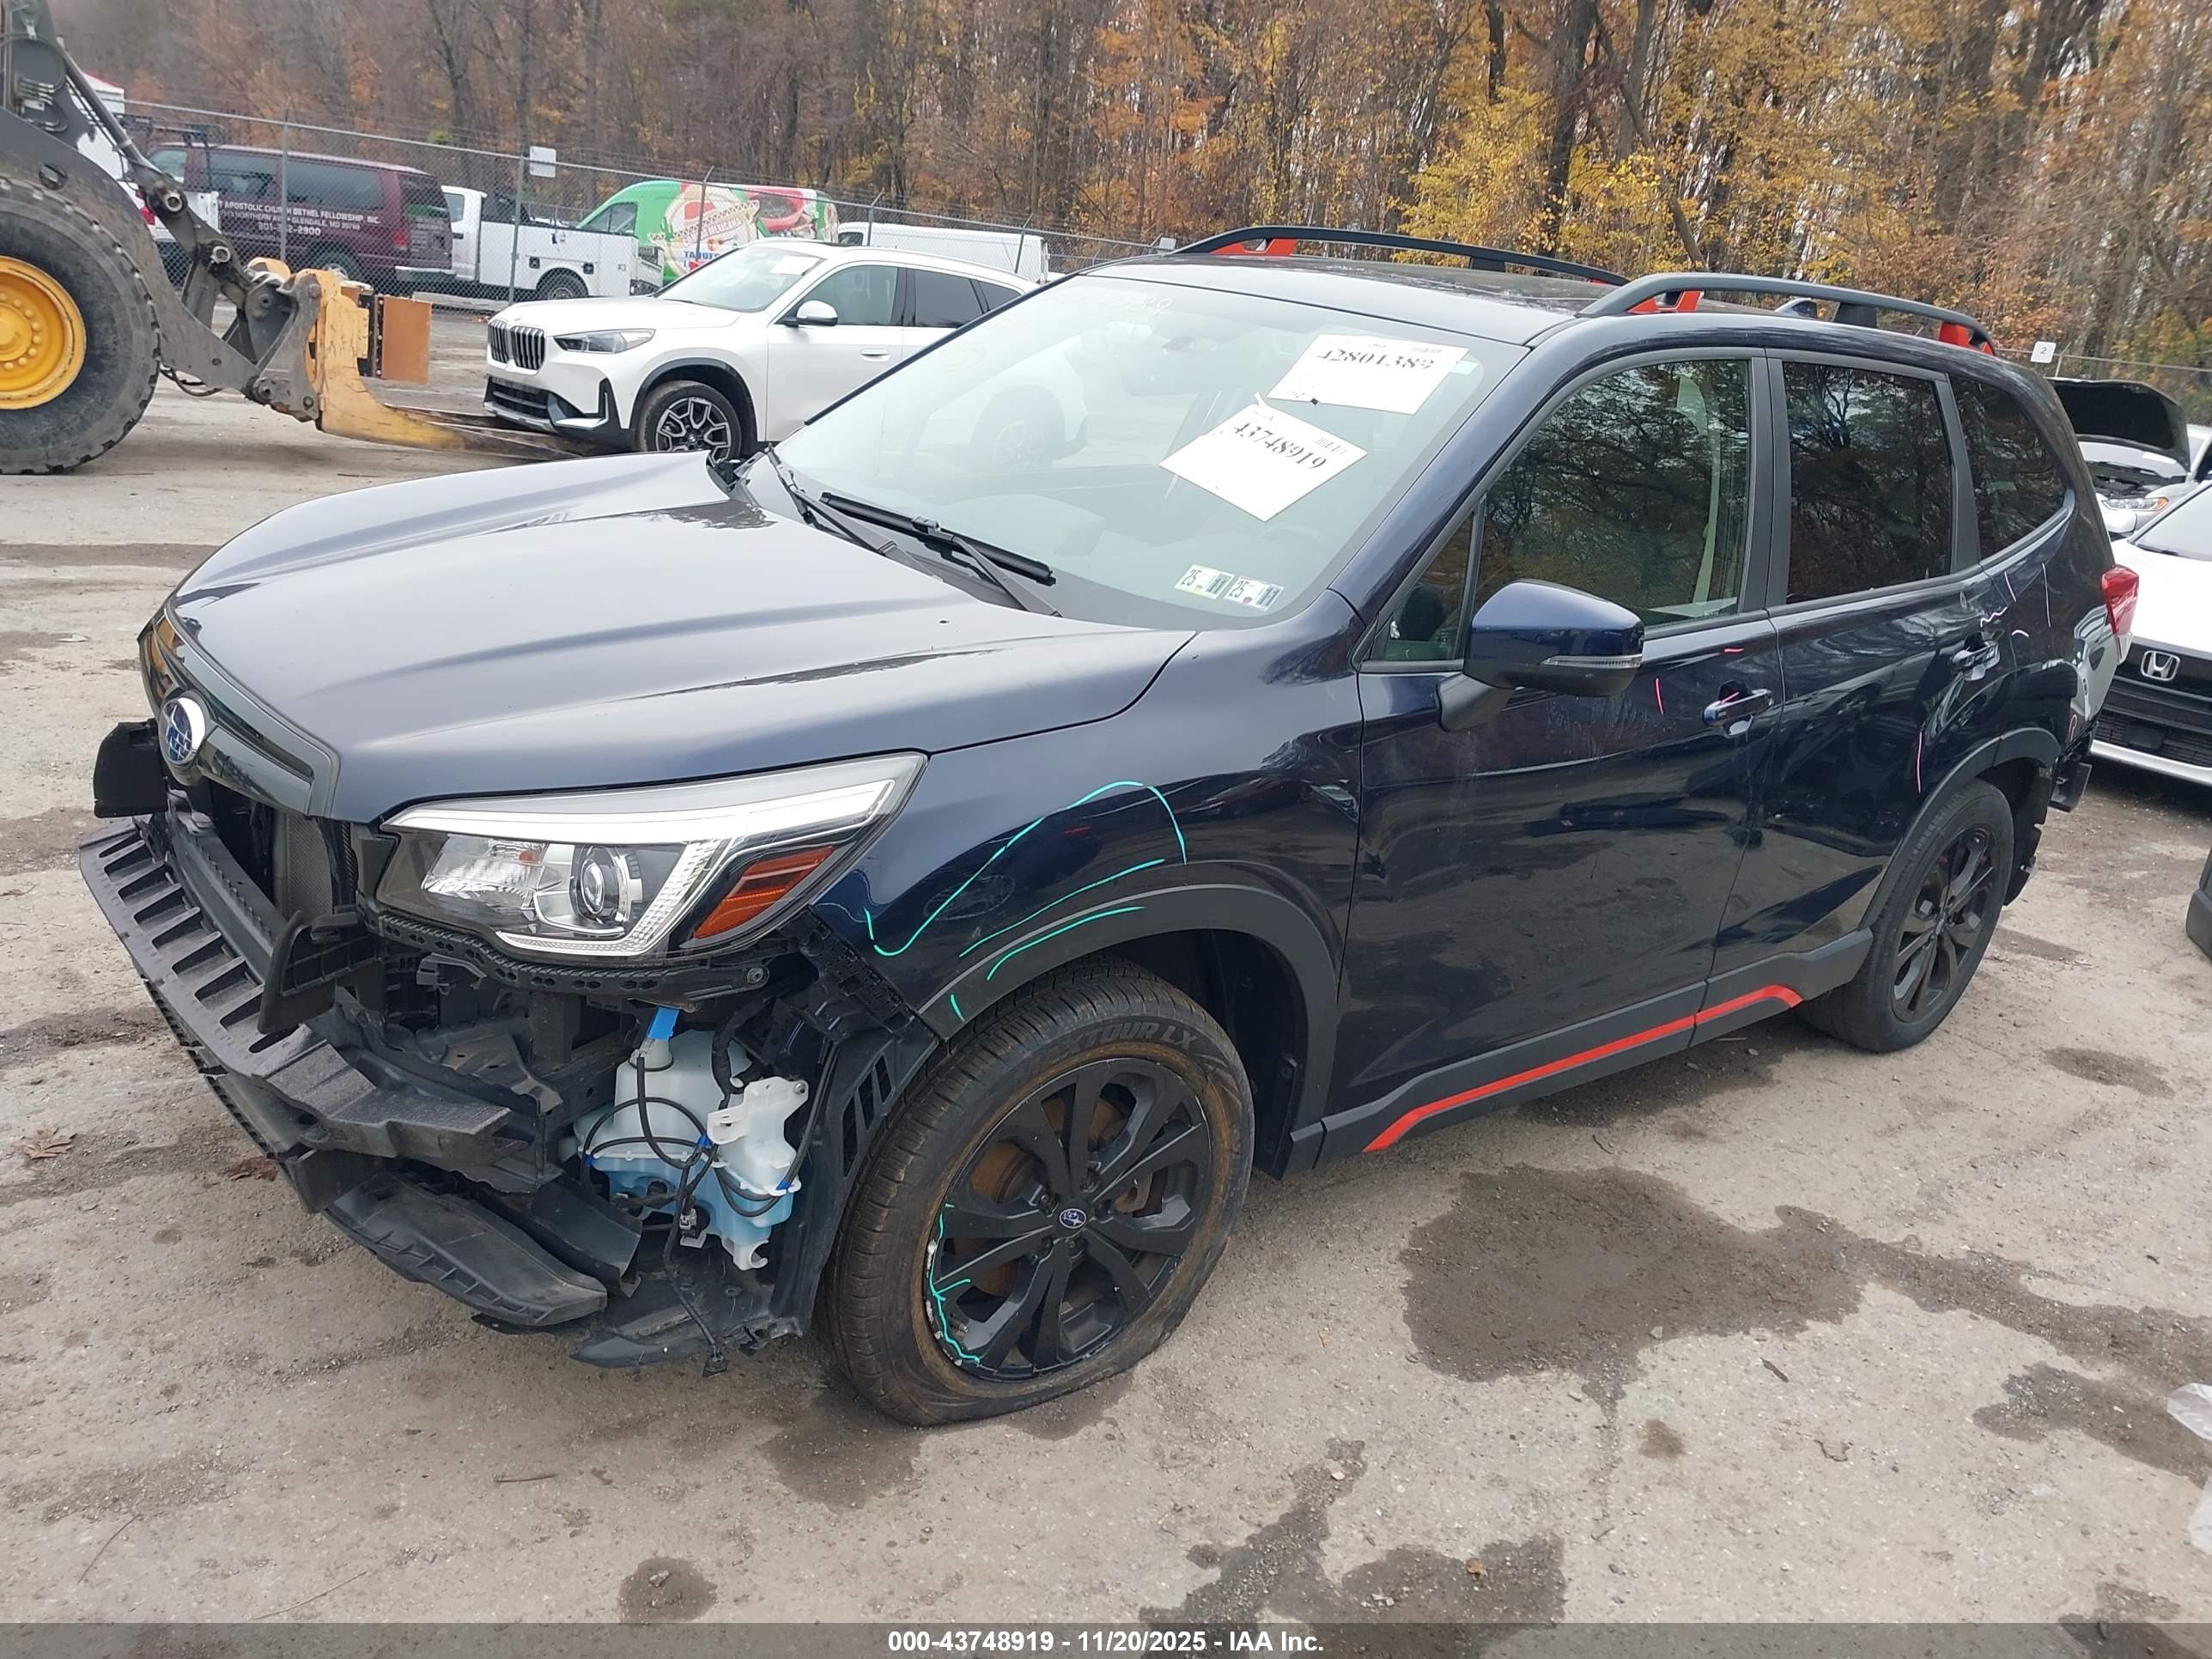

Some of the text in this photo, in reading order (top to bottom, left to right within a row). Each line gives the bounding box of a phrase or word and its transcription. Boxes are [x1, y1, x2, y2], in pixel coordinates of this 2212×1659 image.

[225, 201, 263, 212] APOSTOLIC
[264, 204, 292, 215] CHURH
[293, 208, 319, 217] BETHEL
[1233, 422, 1328, 469] 43748919
[1181, 568, 1202, 586] 25
[1229, 580, 1250, 598] 25
